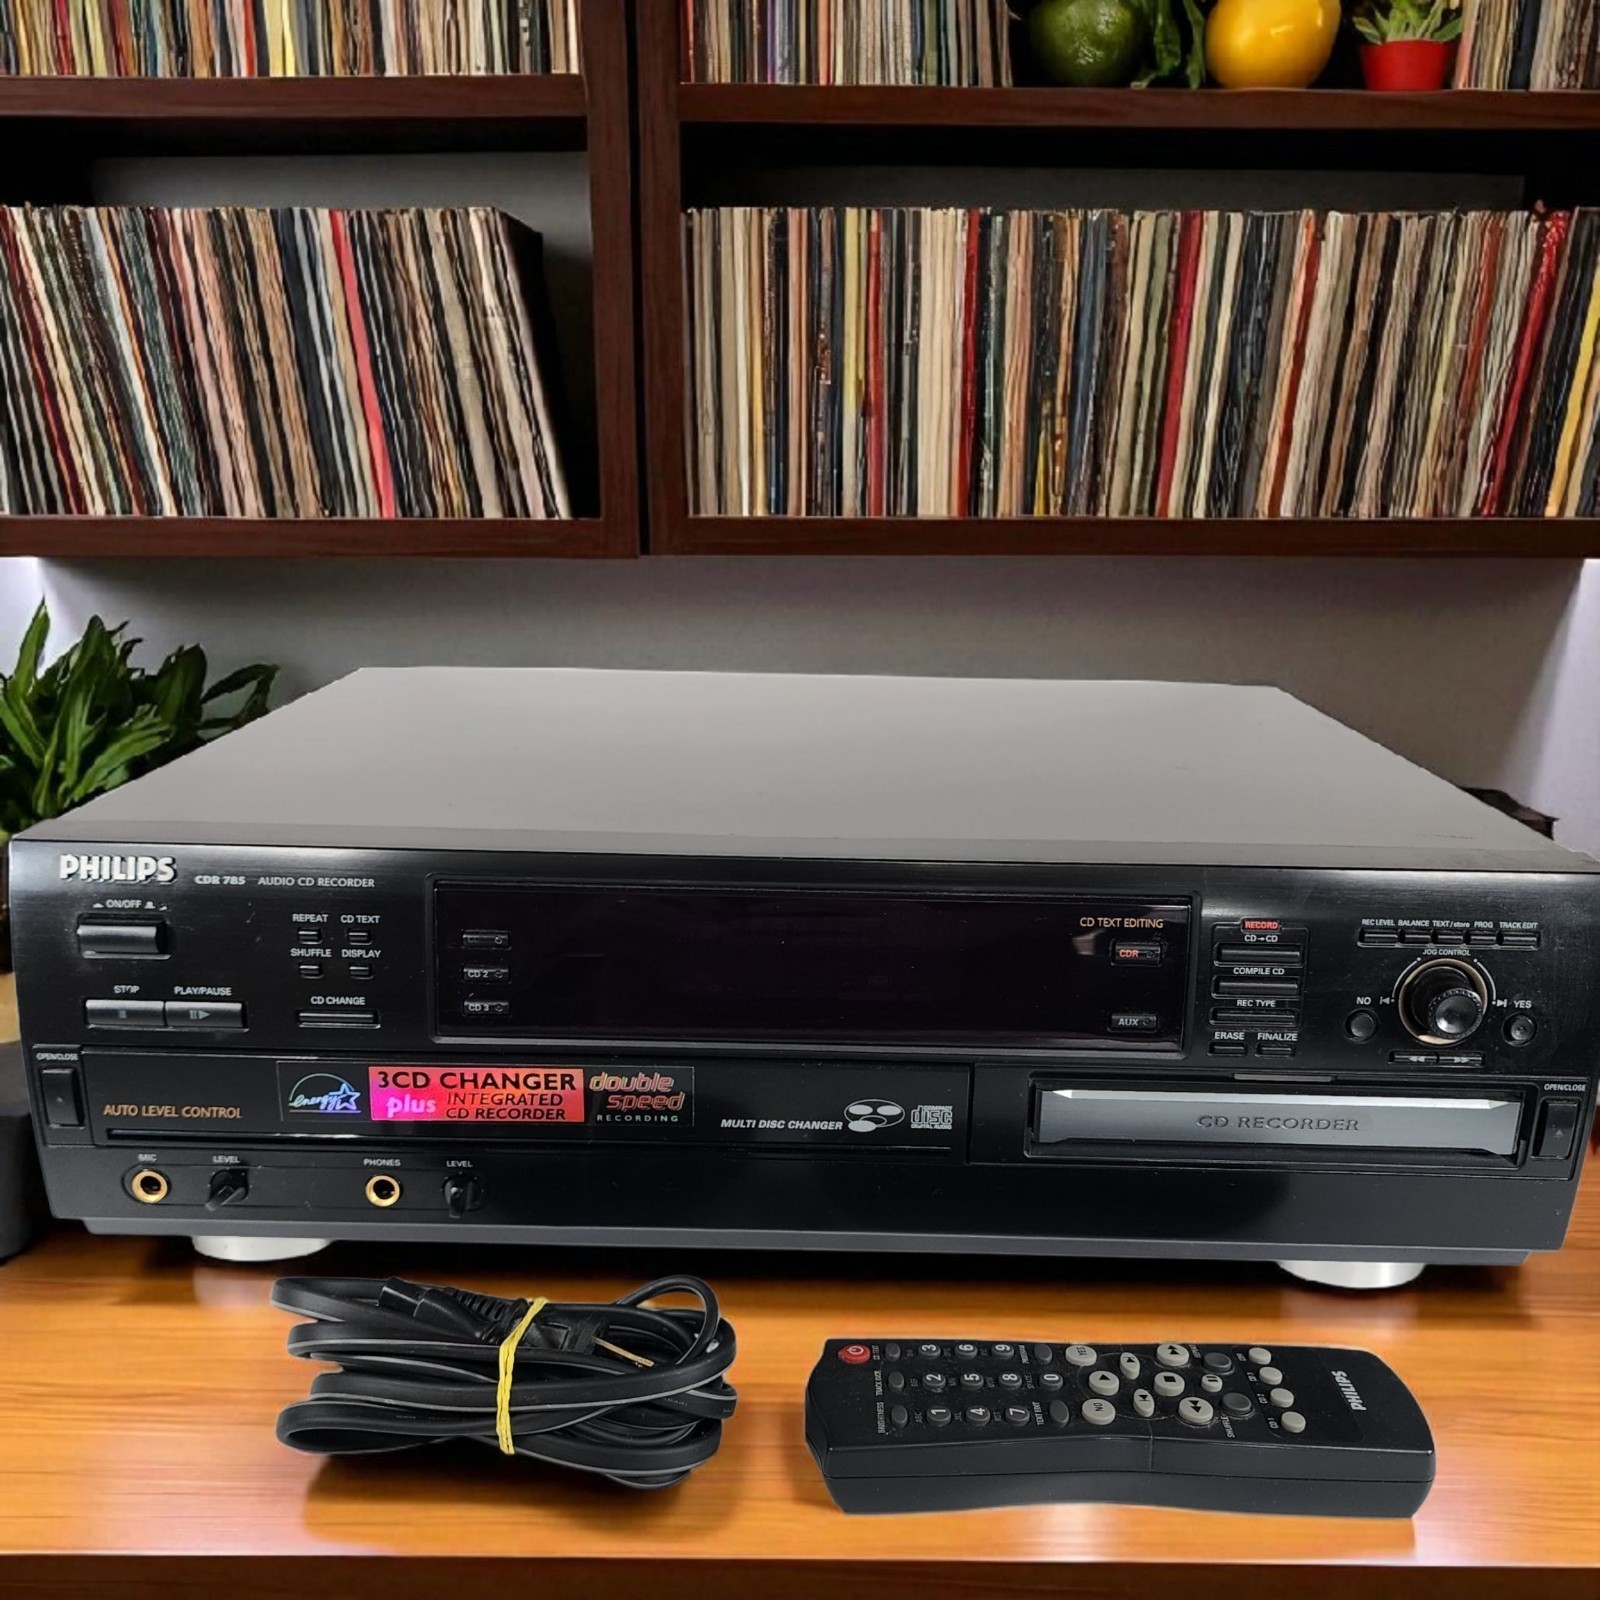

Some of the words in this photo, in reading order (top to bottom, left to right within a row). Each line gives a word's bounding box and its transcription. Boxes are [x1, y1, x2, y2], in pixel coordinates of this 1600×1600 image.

[59, 854, 177, 884] PHILIPS
[194, 875, 220, 885] CDR
[223, 876, 246, 885] 785
[257, 876, 295, 886] AUDIO
[297, 877, 315, 886] CD
[317, 877, 375, 888] RECORDER
[105, 899, 142, 909] ON/OFF
[292, 913, 329, 923] REPEAT
[340, 914, 355, 924] CD
[355, 915, 381, 924] TEXT
[1080, 917, 1095, 927] CD
[1097, 918, 1122, 928] TEXT
[1123, 918, 1164, 929] EDITING
[1361, 918, 1376, 927] REC
[1375, 918, 1396, 927] LEVEL
[1244, 921, 1279, 930] RECORD
[1398, 919, 1430, 928] BALANCE
[1473, 921, 1494, 930] PROG
[1499, 921, 1523, 930] TRACK
[1522, 922, 1539, 930] EDIT
[290, 948, 332, 958] SHUFFLE
[341, 949, 382, 958] DISPLAY
[1119, 949, 1140, 958] CDR
[1423, 948, 1437, 956] JOG
[1438, 949, 1471, 957] CONTROL
[467, 969, 481, 979] CD
[482, 970, 489, 978] 2
[1233, 967, 1271, 976] COMPILE
[1272, 968, 1286, 976] CD
[113, 984, 140, 994] STOP
[173, 986, 233, 996] PLAY/PAUSE
[310, 996, 325, 1005] CD
[325, 996, 366, 1006] CHANGE
[1236, 999, 1254, 1007] REC
[1255, 1000, 1277, 1008] TYPE
[1356, 996, 1372, 1006] NO
[1513, 1000, 1532, 1009] YES
[468, 1003, 482, 1012] CD
[483, 1003, 490, 1012] 3
[1117, 1017, 1140, 1027] AUX
[1214, 1031, 1246, 1041] ERASE
[1257, 1032, 1299, 1042] FINALIZE
[36, 1052, 79, 1061] OPEN/CLOSE
[378, 1071, 431, 1089] 3CD
[439, 1072, 577, 1091] CHANGER
[589, 1071, 675, 1092] double
[1543, 1083, 1587, 1093] OPEN/CLOSE
[447, 1093, 564, 1107] INTEGRATED
[607, 1092, 685, 1112] speed
[103, 1104, 139, 1116] AUTO
[141, 1105, 179, 1117] LEVEL
[181, 1106, 243, 1119] CONTROL
[386, 1094, 438, 1119] plus
[446, 1107, 470, 1119] CD
[474, 1108, 567, 1121] RECORDER
[597, 1115, 679, 1123] RECORDING
[720, 1119, 756, 1129] MULTI
[758, 1120, 786, 1130] DISC
[788, 1121, 844, 1131] CHANGER
[1197, 1115, 1229, 1129] CD
[1237, 1116, 1360, 1131] RECORDER
[138, 1153, 157, 1163] MIC
[213, 1155, 240, 1164] LEVEL
[363, 1158, 401, 1168] PHONES
[447, 1160, 473, 1169] LEVEL
[1075, 1346, 1087, 1356] YES
[963, 1373, 980, 1381] 5
[1002, 1373, 1018, 1381] 8
[1043, 1373, 1060, 1381] 0
[1330, 1370, 1367, 1411] PHILIPS
[969, 1407, 986, 1416] 4
[1008, 1407, 1026, 1416] 7
[1092, 1402, 1104, 1412] NO
[876, 1401, 886, 1433] BRIGHTNESS
[1220, 1415, 1235, 1438] SHUFFLE
[1268, 1421, 1279, 1429] CD
